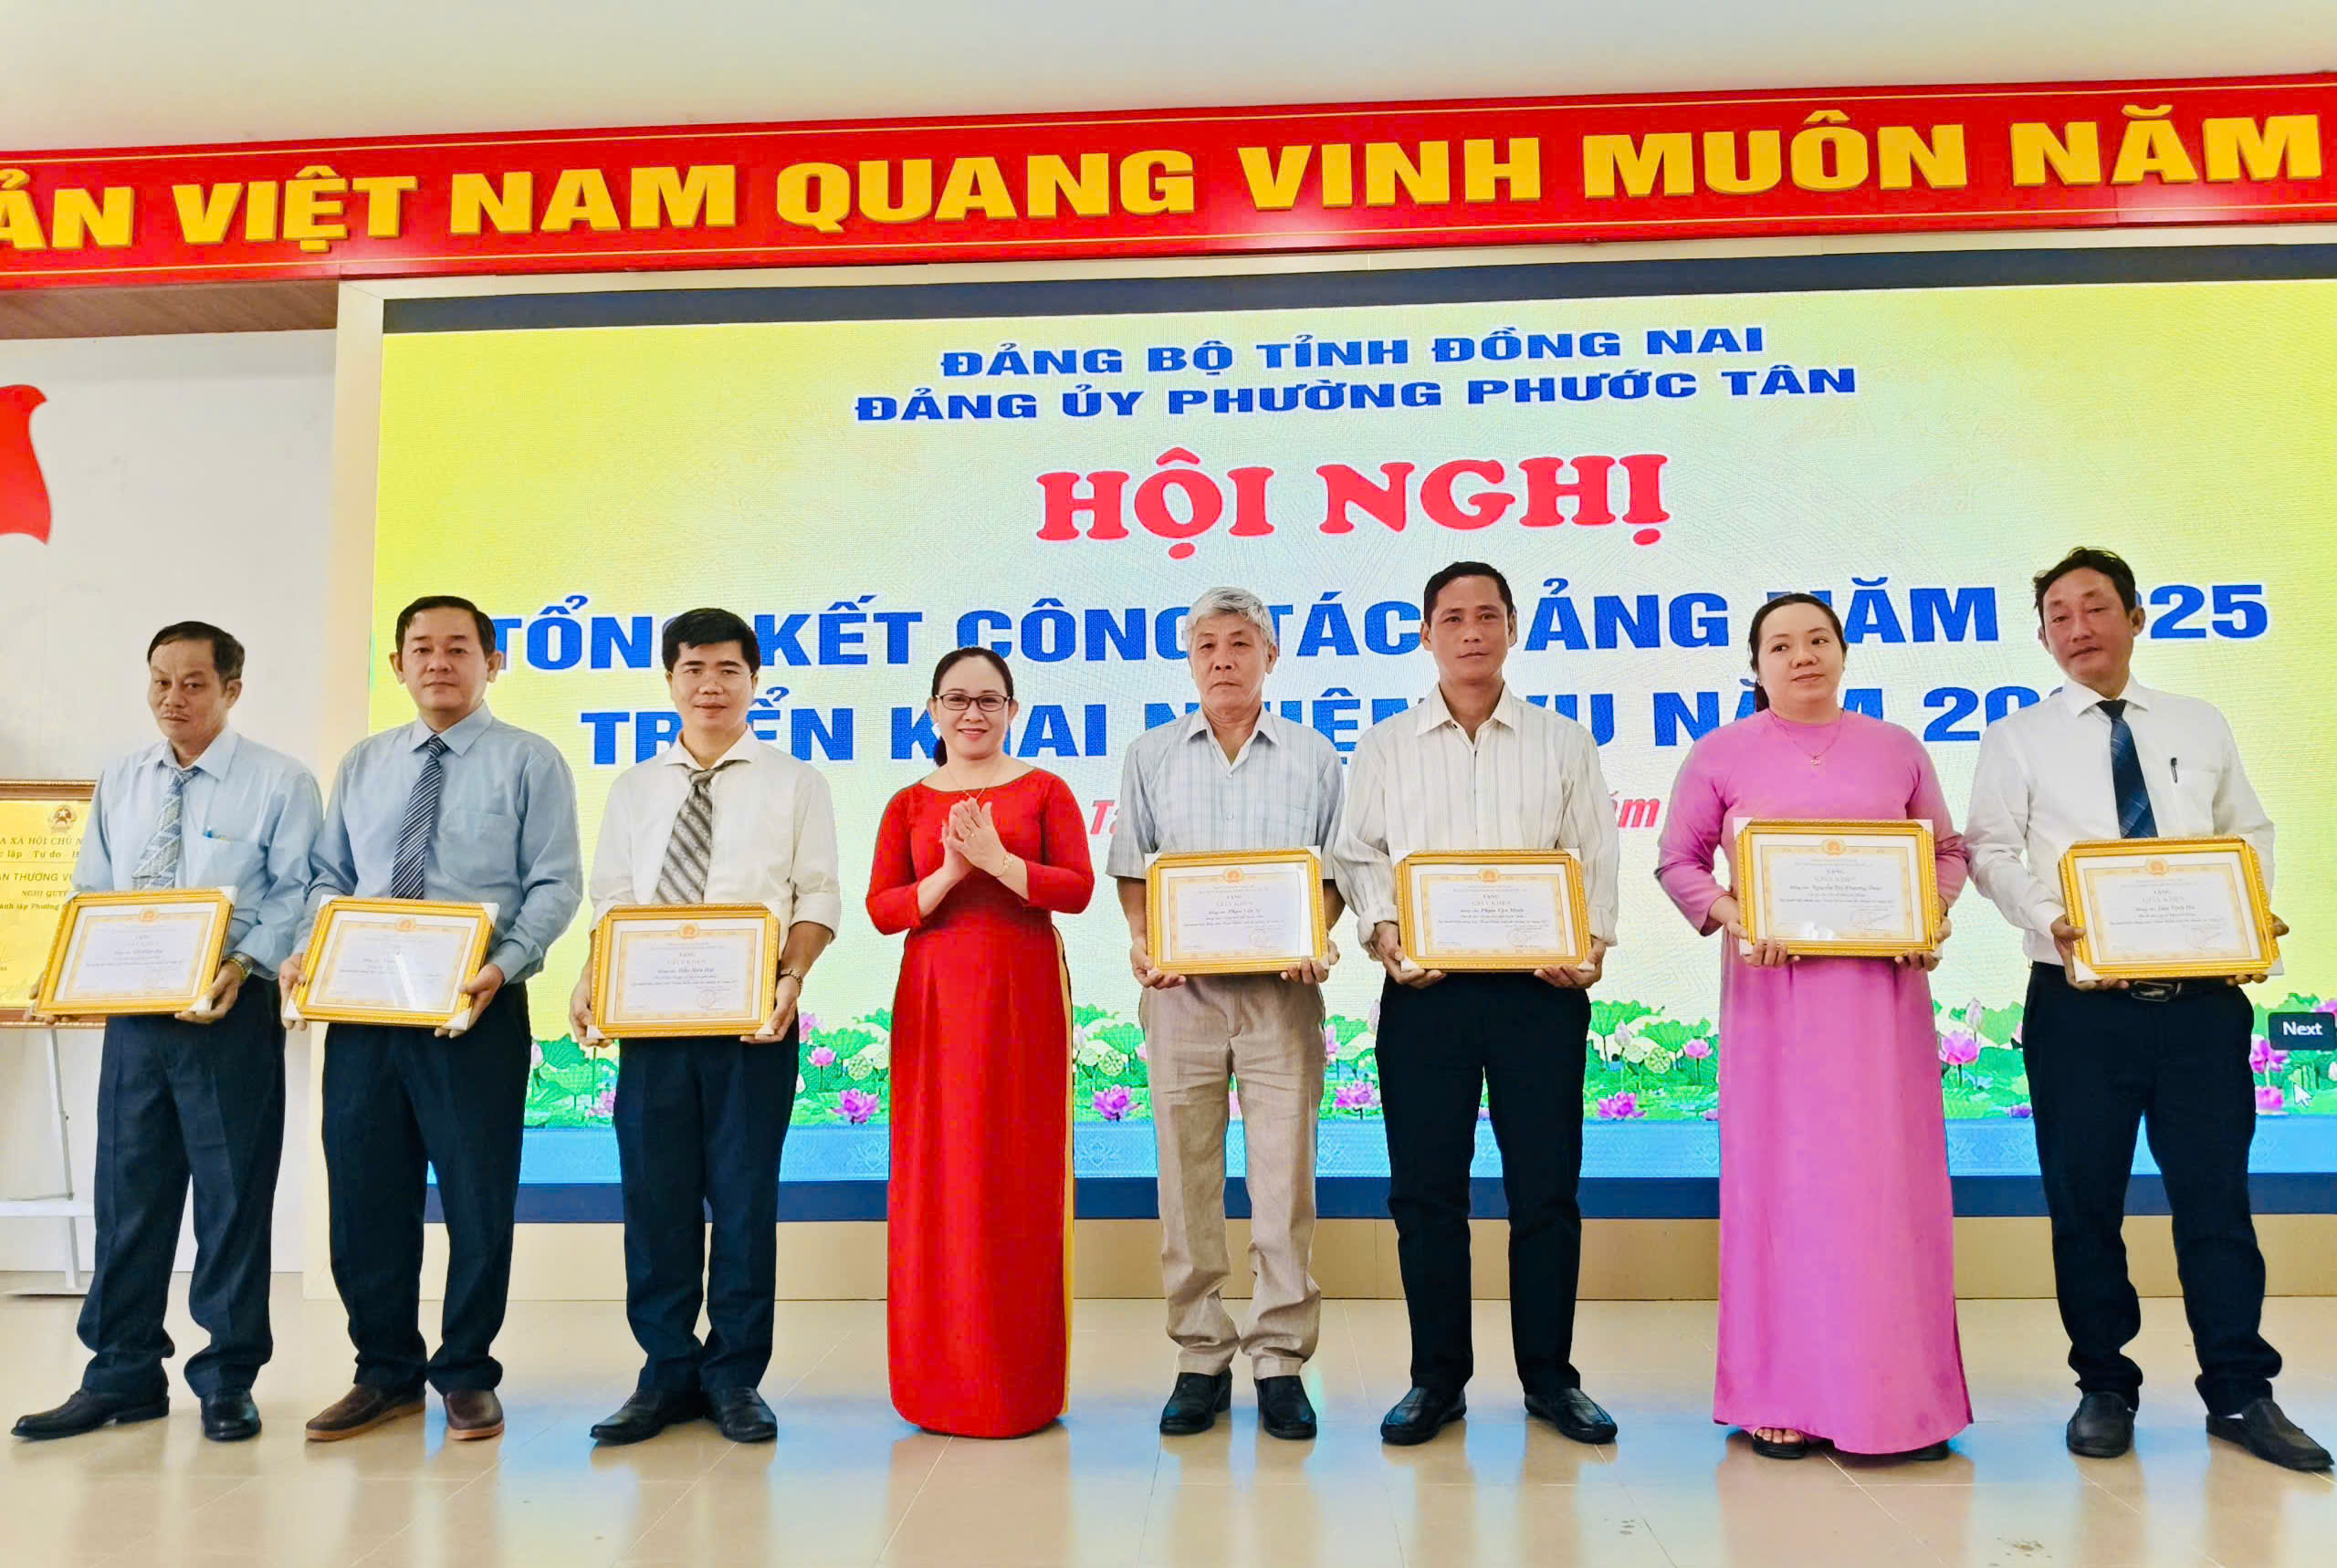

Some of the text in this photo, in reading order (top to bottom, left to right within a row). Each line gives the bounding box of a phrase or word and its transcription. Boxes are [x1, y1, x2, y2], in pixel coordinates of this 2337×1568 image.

[173, 164, 418, 253] VIỆT
[449, 163, 736, 235] NAM
[776, 151, 1194, 234] QUANG
[1238, 136, 1542, 212] VINH
[1583, 109, 1968, 199] MUÔN
[2009, 104, 2323, 188] NĂM
[940, 326, 1764, 377] ĐẢNG BỘ TỈNH ĐỒNG NAI
[854, 364, 1856, 421] ĐẢNG ỦY PHƯỜNG PHƯỚC TÂN
[1035, 446, 1671, 559] HỘI NGHỊ
[493, 595, 670, 670] TỔN
[754, 594, 922, 667] KẾT
[1525, 578, 1729, 651] ẢNG
[1766, 577, 1999, 643] ĂM
[2135, 583, 2269, 640] 25
[891, 703, 1107, 760] KAI
